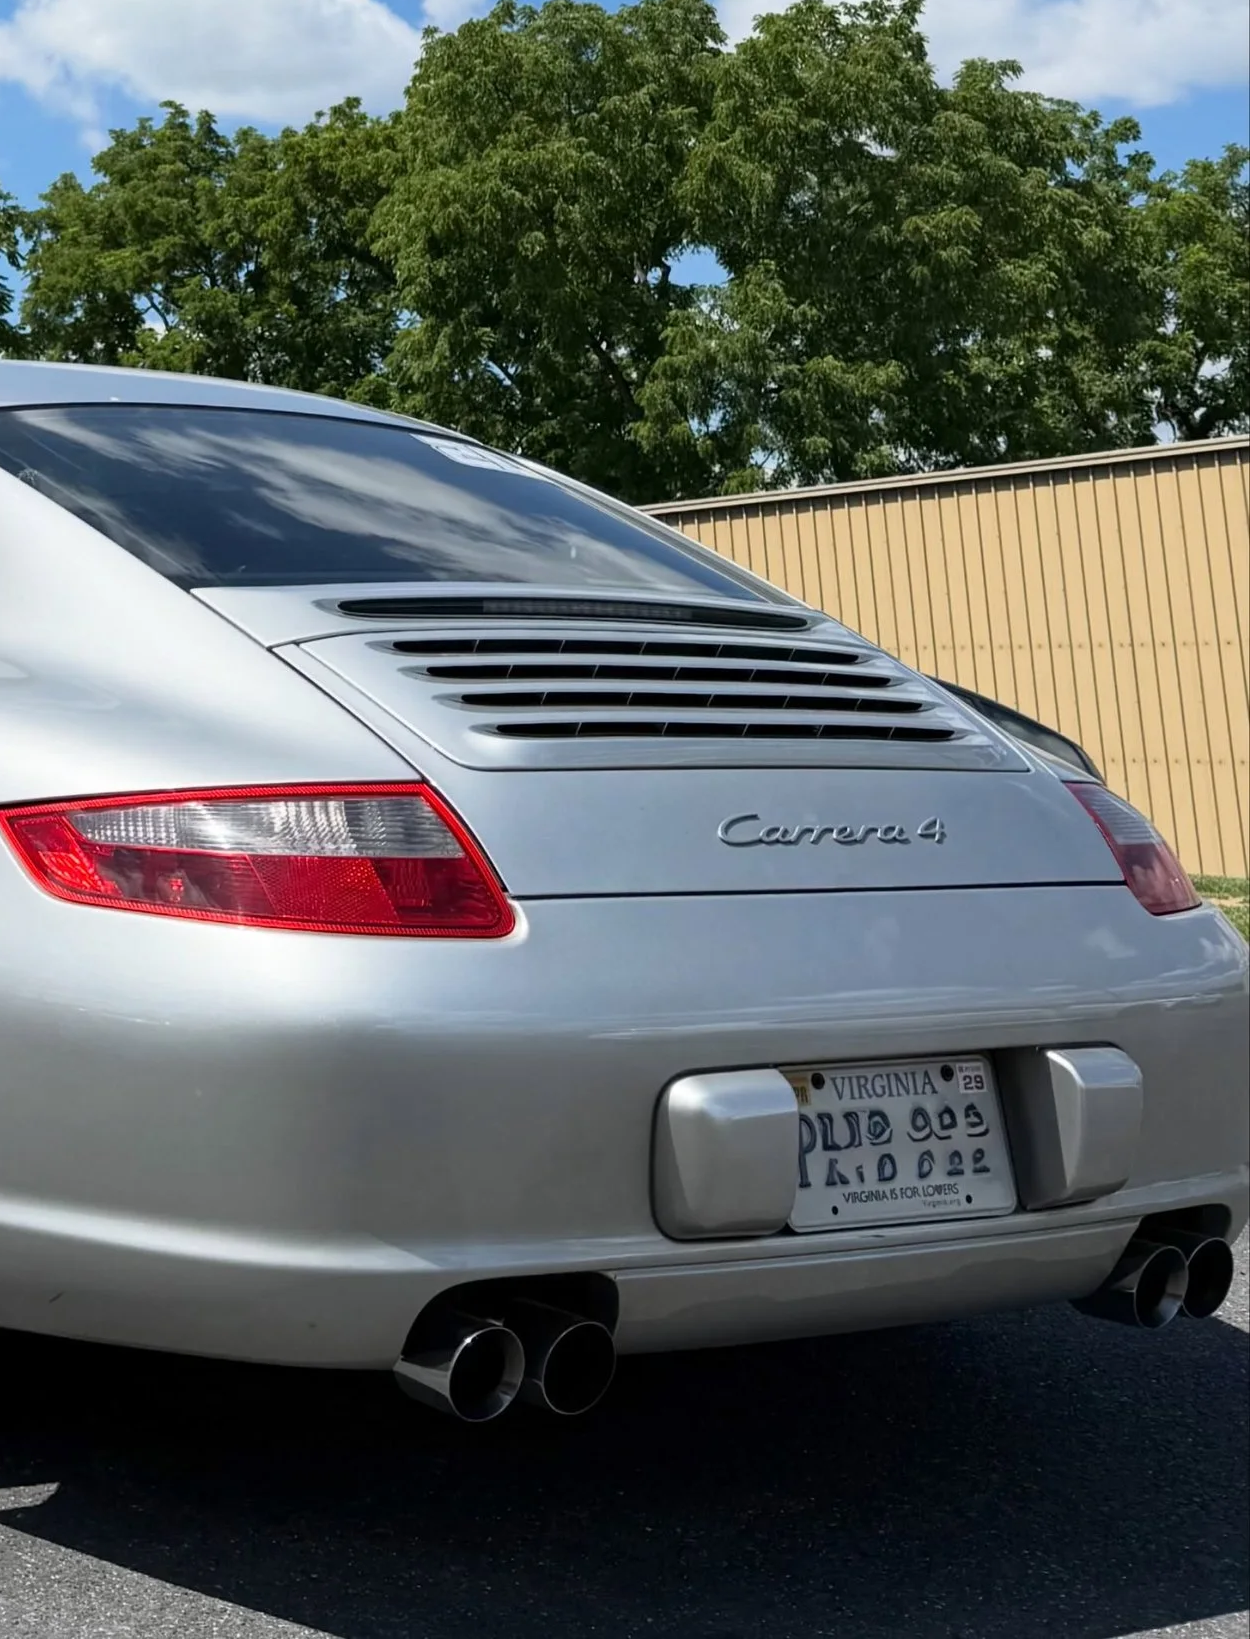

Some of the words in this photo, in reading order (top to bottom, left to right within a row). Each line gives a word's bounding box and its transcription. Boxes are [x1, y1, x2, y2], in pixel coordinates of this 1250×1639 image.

[718, 814, 912, 847] Carrera
[917, 817, 947, 844] 4
[831, 1070, 938, 1101] VIRGINIA
[962, 1074, 985, 1091] 29
[843, 1190, 889, 1203] VIRGINIA
[890, 1188, 898, 1200] IS
[900, 1186, 921, 1199] FOR
